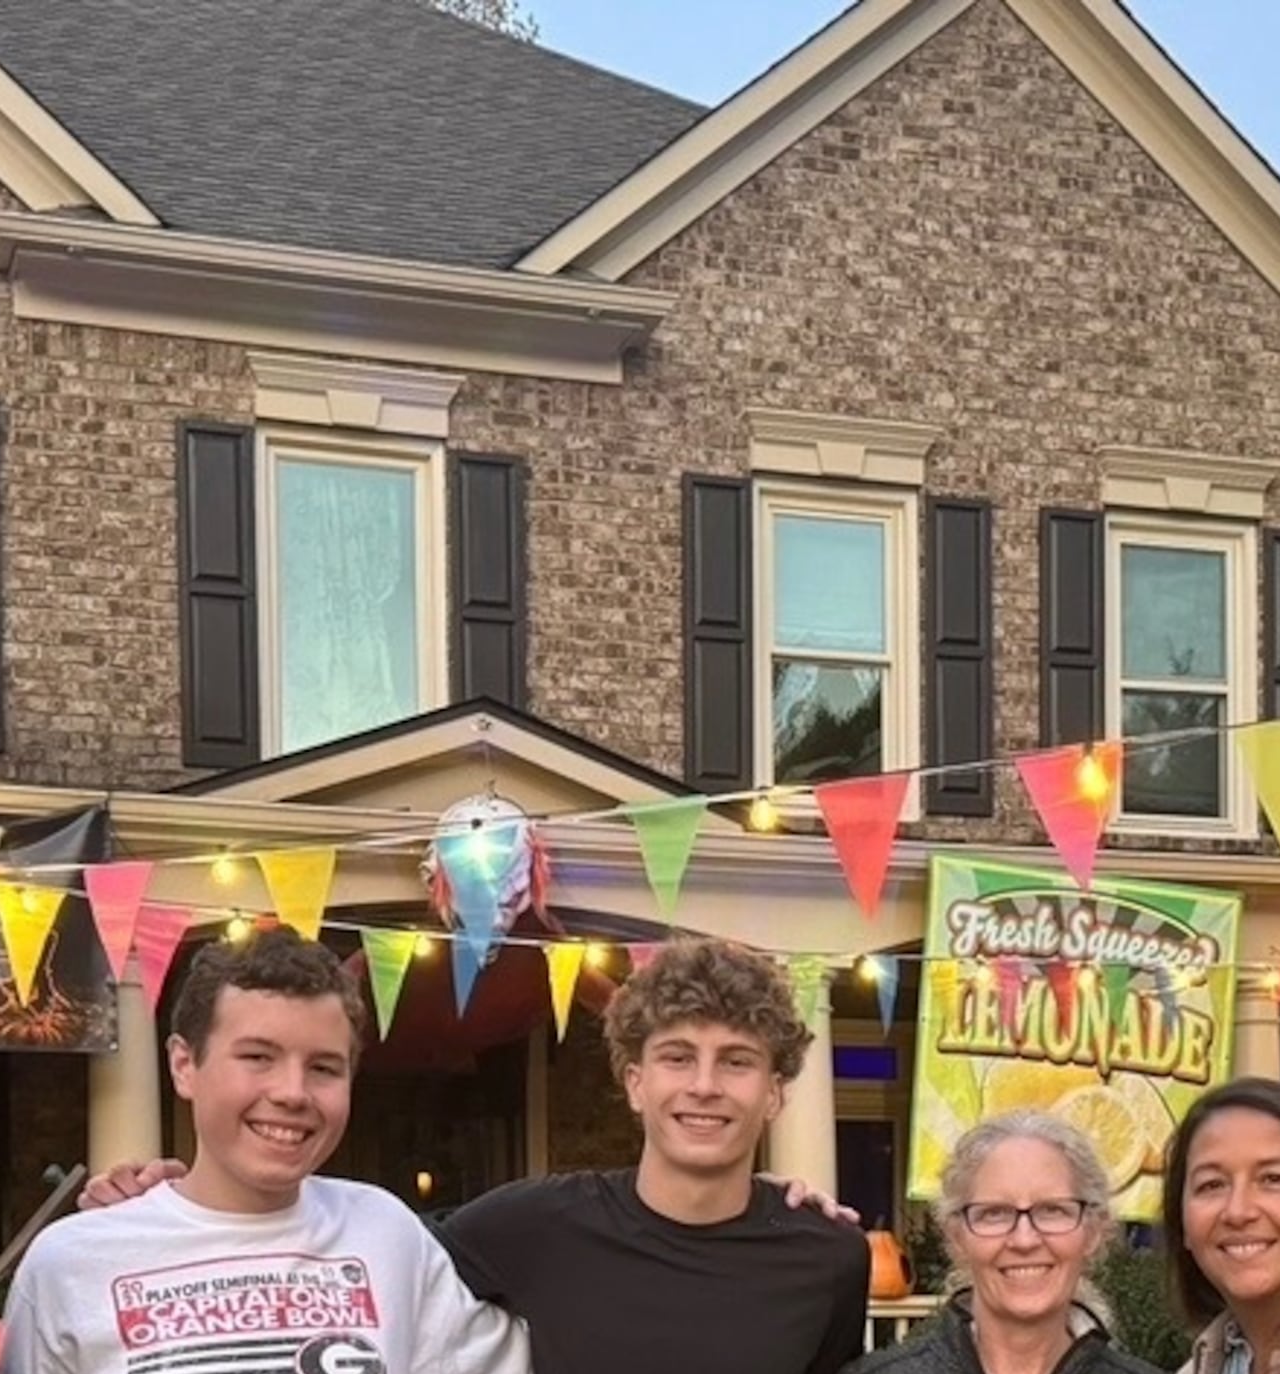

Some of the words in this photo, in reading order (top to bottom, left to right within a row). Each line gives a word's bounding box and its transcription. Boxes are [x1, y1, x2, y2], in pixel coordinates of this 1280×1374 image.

[950, 903, 1060, 957] Fresh
[1061, 909, 1218, 985] Squeezed
[938, 966, 1213, 1084] LEMONADE
[127, 1307, 279, 1344] ORANGE
[284, 1305, 378, 1327] BOWL
[148, 1287, 287, 1320] CAPITAL
[290, 1286, 351, 1309] ONE
